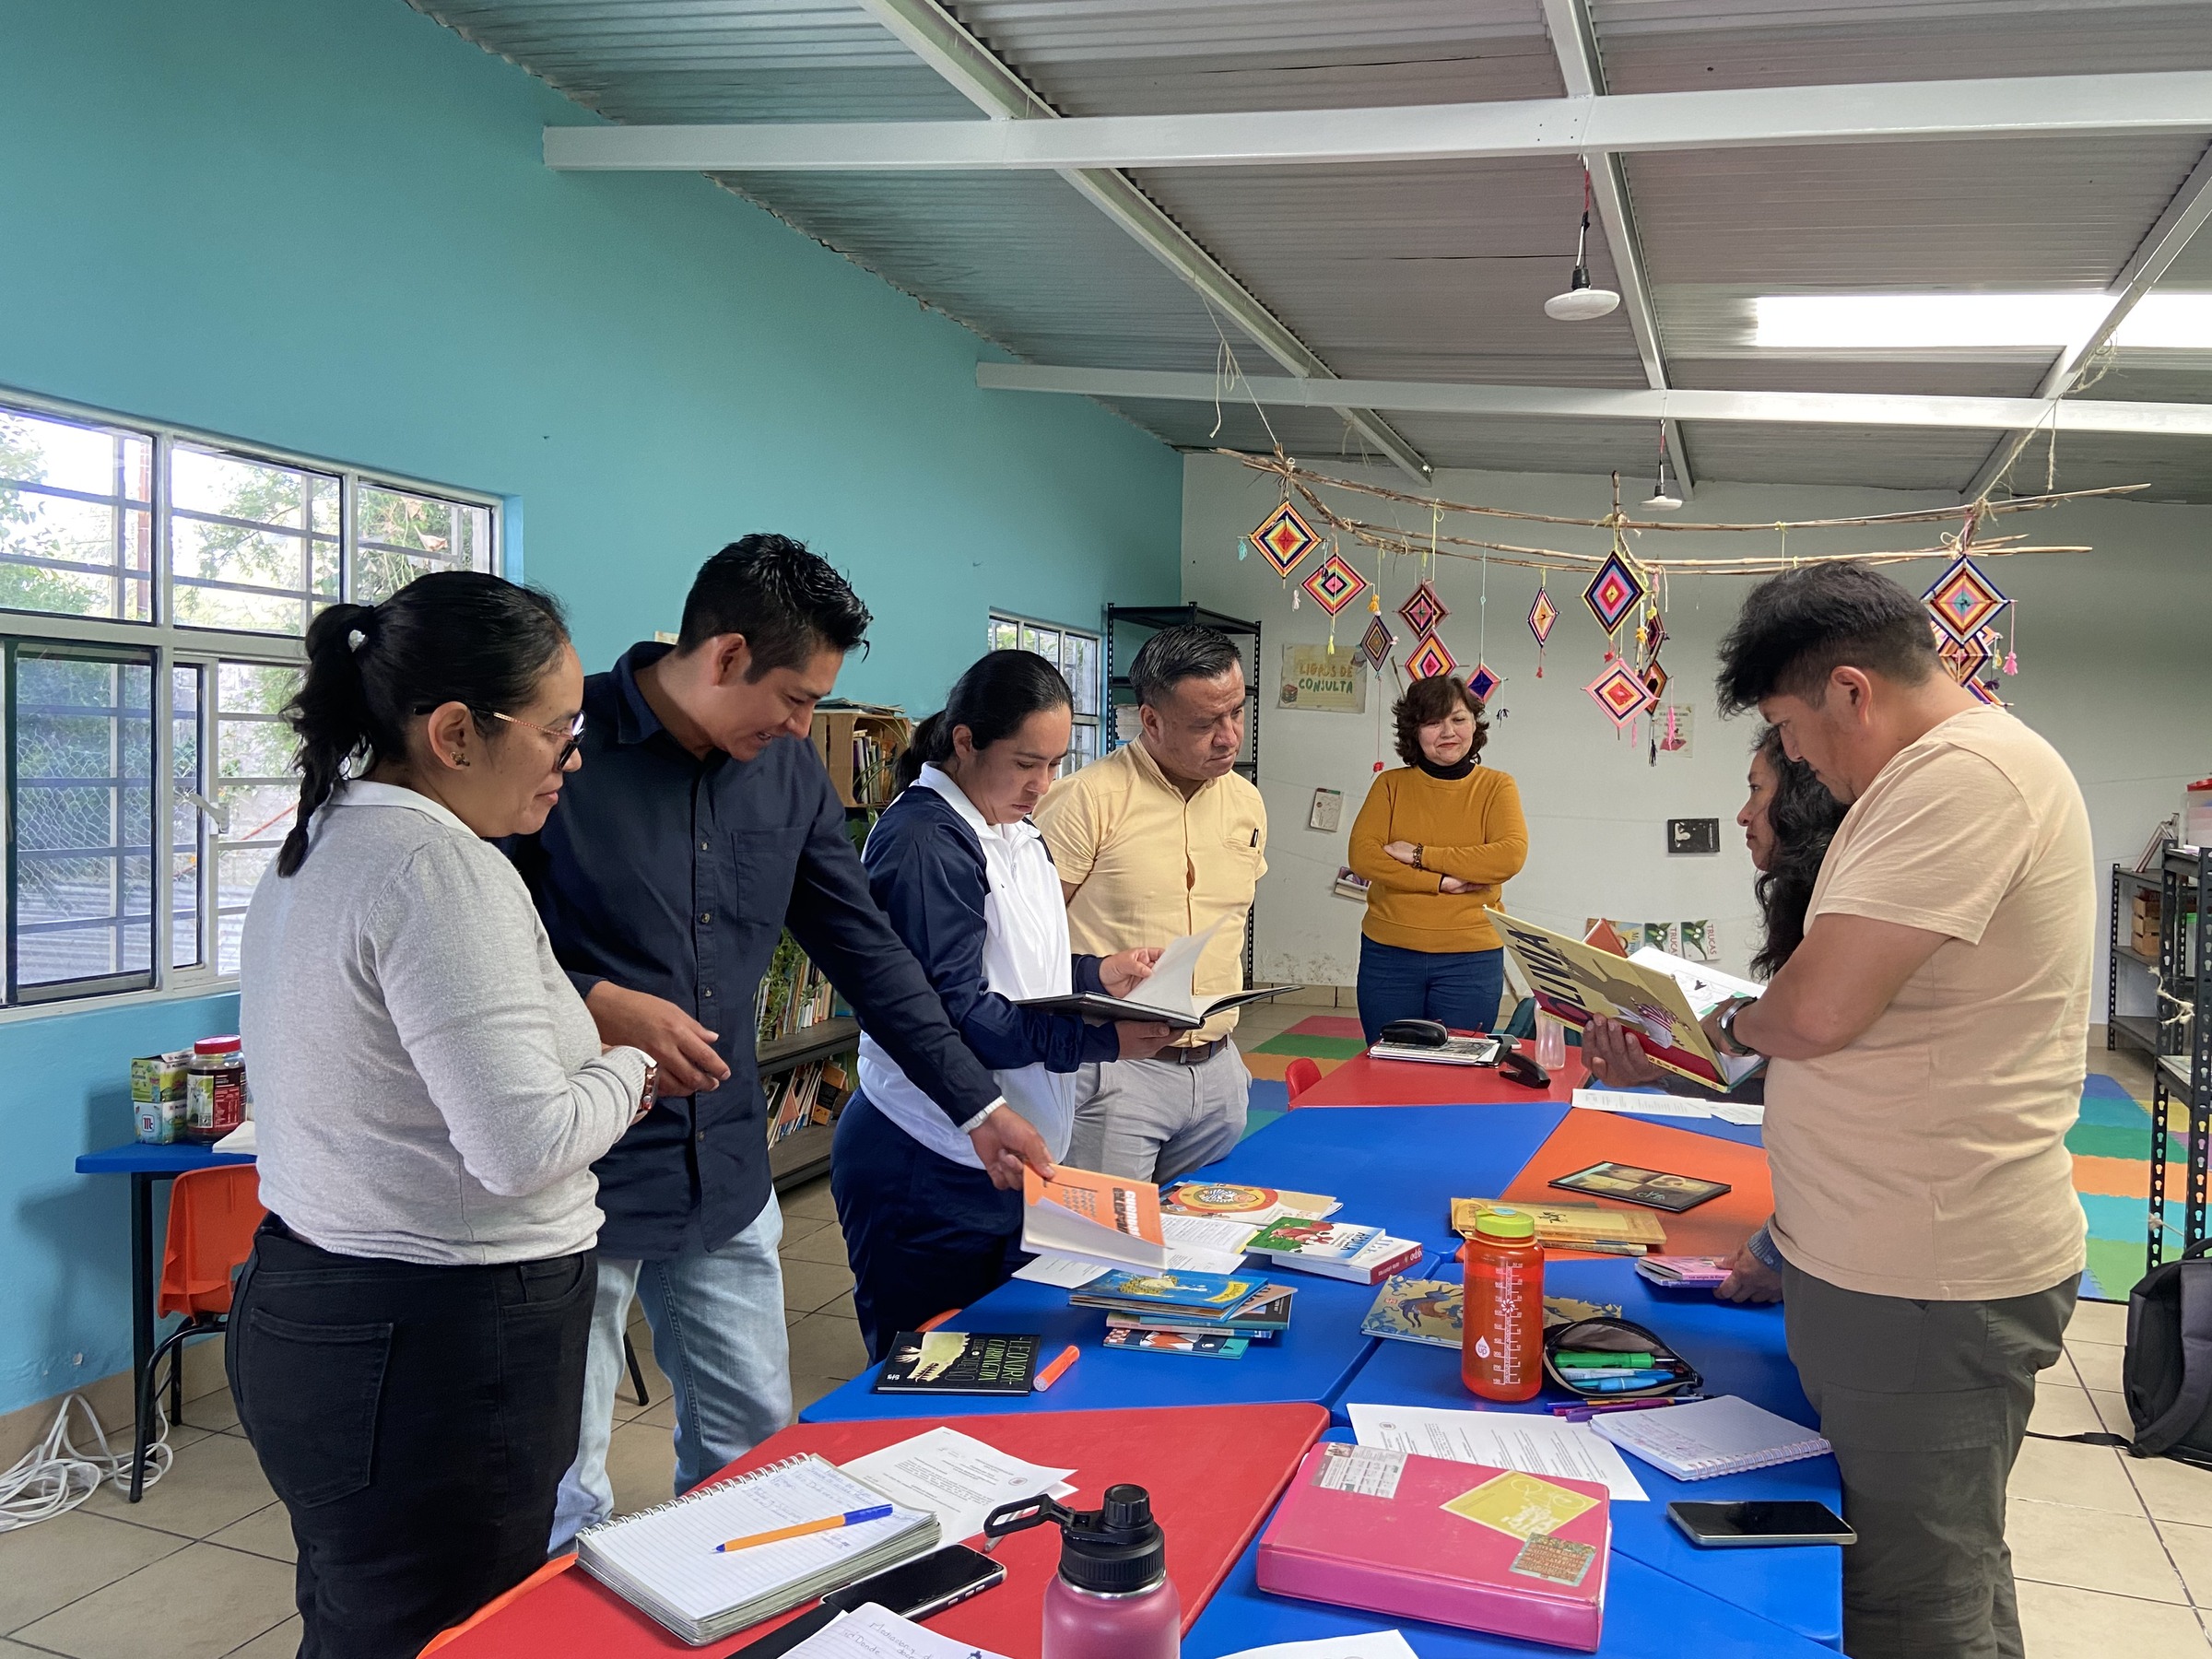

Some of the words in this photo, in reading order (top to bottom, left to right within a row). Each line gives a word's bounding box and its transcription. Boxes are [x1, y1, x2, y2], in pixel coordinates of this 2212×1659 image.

[1300, 663, 1337, 677] LIBROS
[1339, 665, 1353, 677] DE
[1298, 678, 1354, 694] CONSULTA
[1630, 930, 1639, 941] Mi
[1707, 924, 1717, 955] TRUCAS
[1507, 929, 1594, 1026] OLIVIA
[978, 1338, 1006, 1382] CARRINGTON
